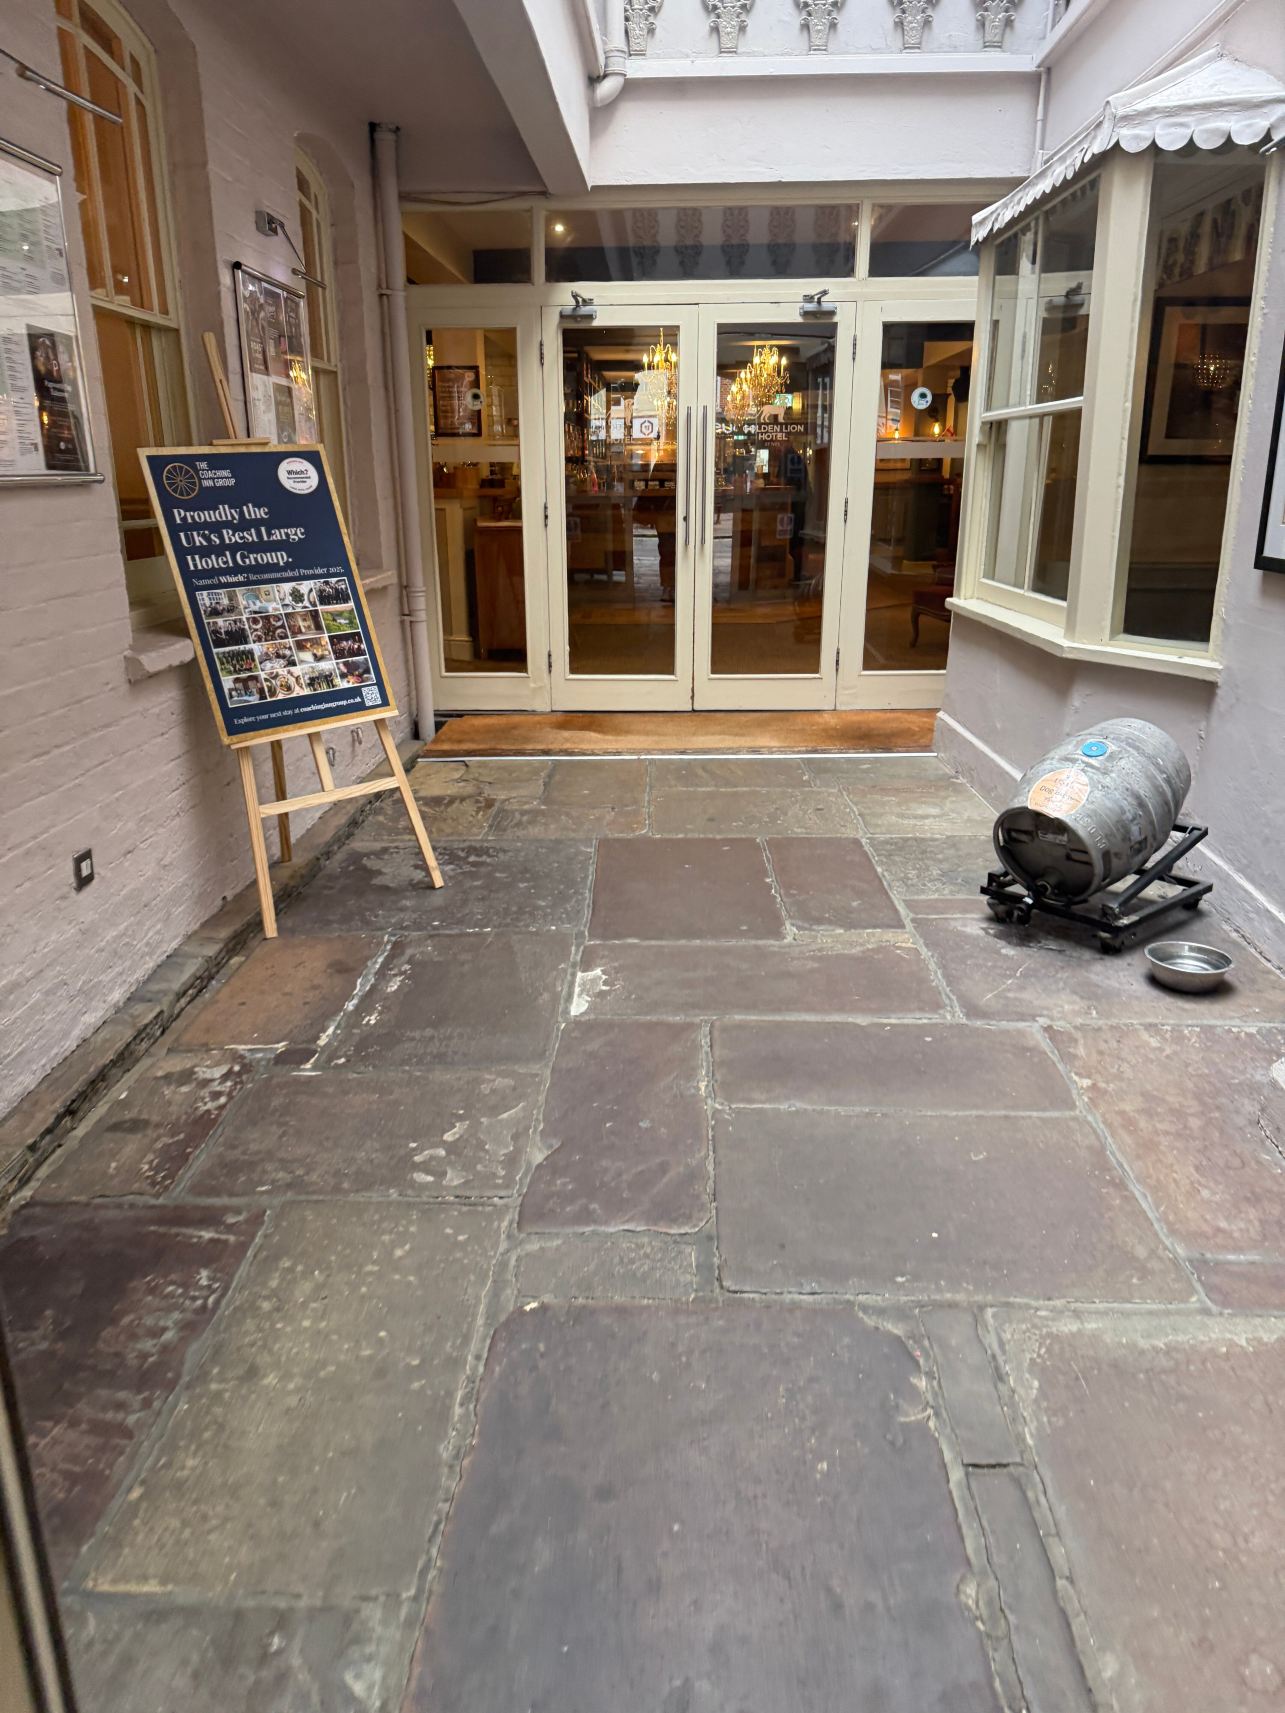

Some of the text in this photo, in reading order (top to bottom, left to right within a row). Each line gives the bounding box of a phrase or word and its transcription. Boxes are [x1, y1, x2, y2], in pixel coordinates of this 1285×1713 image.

[783, 424, 804, 432] LION
[195, 461, 209, 470] THE
[199, 469, 232, 479] COACHING
[201, 478, 236, 488] INN GROUP
[172, 503, 270, 524] Proudly the
[179, 525, 306, 548] UK's Best Large
[186, 550, 293, 571] Hotel Group.
[192, 576, 219, 586] Named
[219, 574, 247, 584] Which?
[249, 569, 299, 580] Recommended
[300, 567, 328, 576] Provider
[233, 716, 256, 726] Explore
[256, 714, 269, 722] your
[270, 711, 282, 719] next
